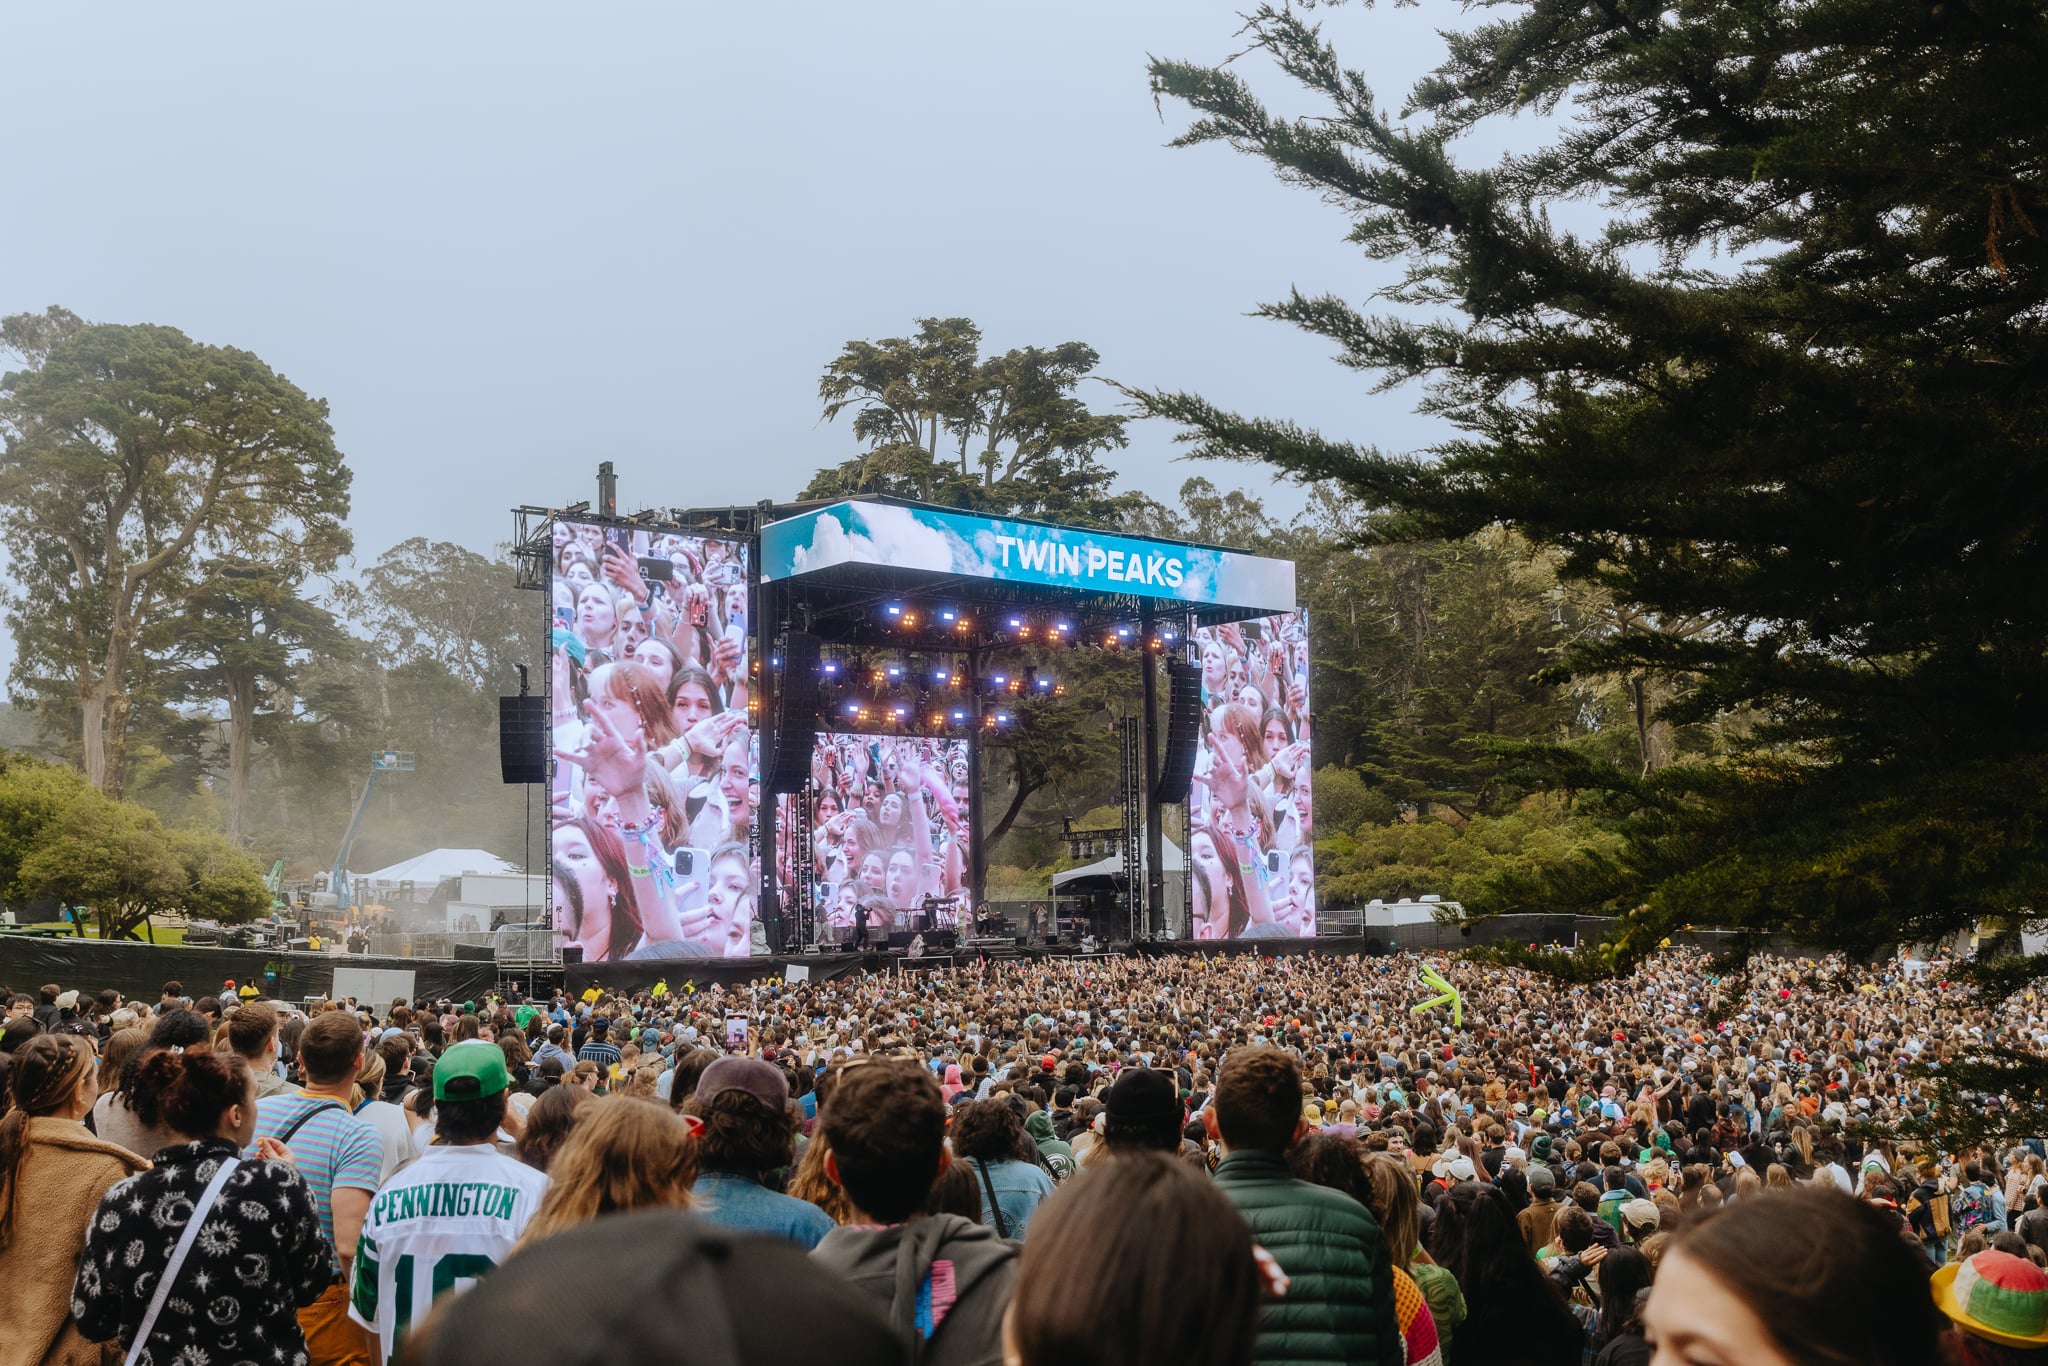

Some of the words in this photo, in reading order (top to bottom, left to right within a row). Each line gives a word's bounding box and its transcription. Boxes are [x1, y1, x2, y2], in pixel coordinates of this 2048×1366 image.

[996, 535, 1079, 576] TWIN
[1088, 548, 1184, 588] PEAKS
[374, 1183, 520, 1227] PENNINGTON
